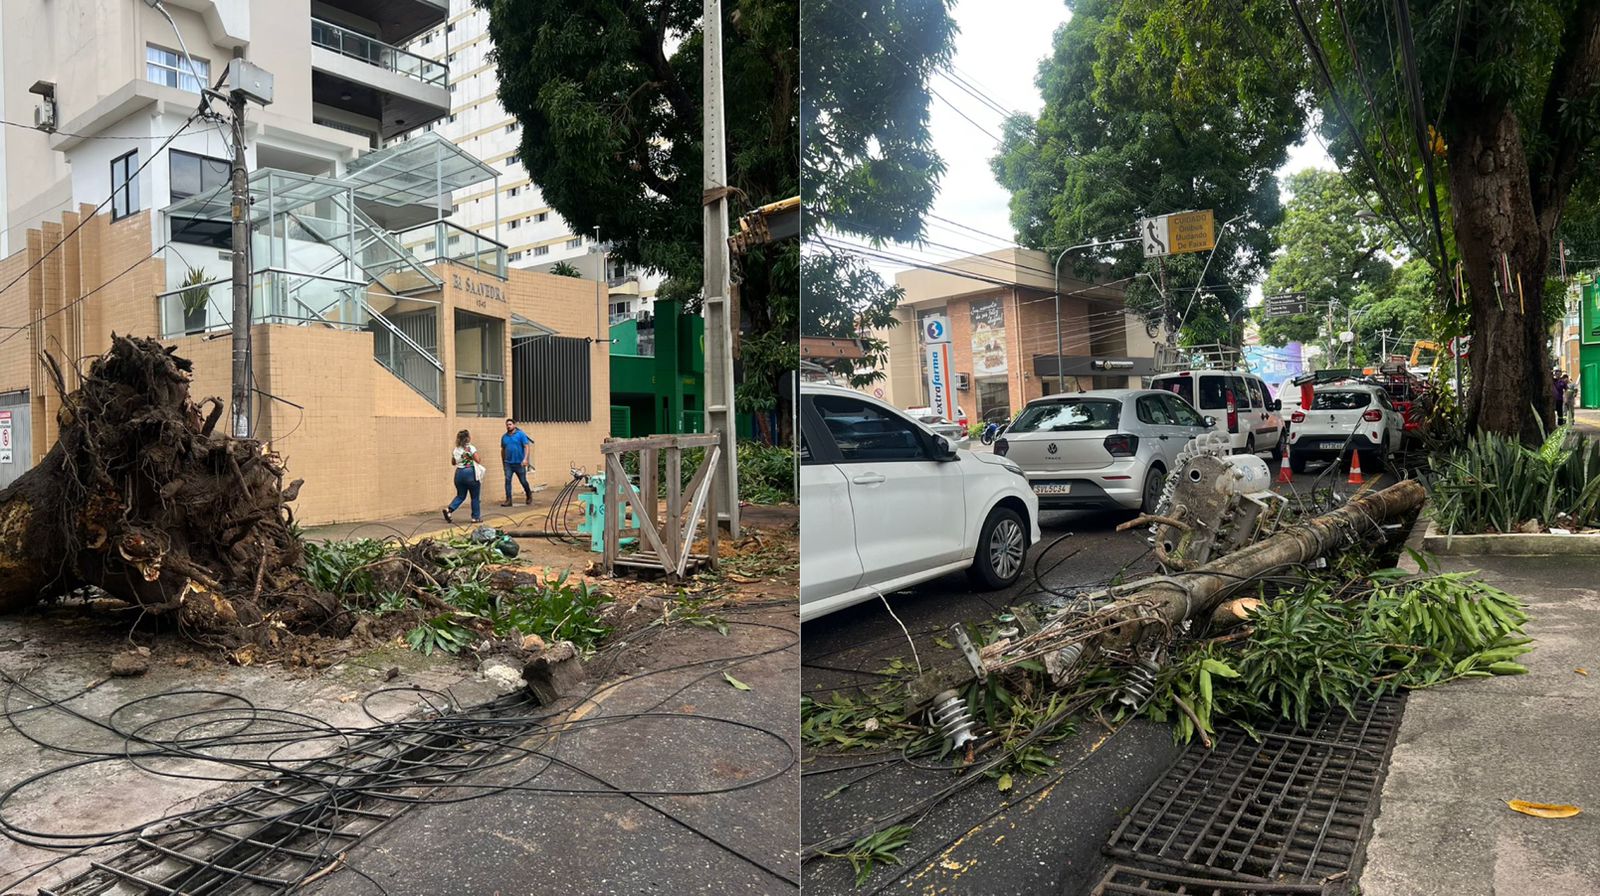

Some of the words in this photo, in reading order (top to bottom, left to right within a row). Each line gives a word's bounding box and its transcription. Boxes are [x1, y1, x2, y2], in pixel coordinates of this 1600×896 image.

[1174, 214, 1207, 225] CUIDADO
[1175, 232, 1207, 241] Mudando
[1178, 242, 1186, 250] De
[1189, 240, 1207, 249] Faixa
[931, 351, 943, 415] extrafarma
